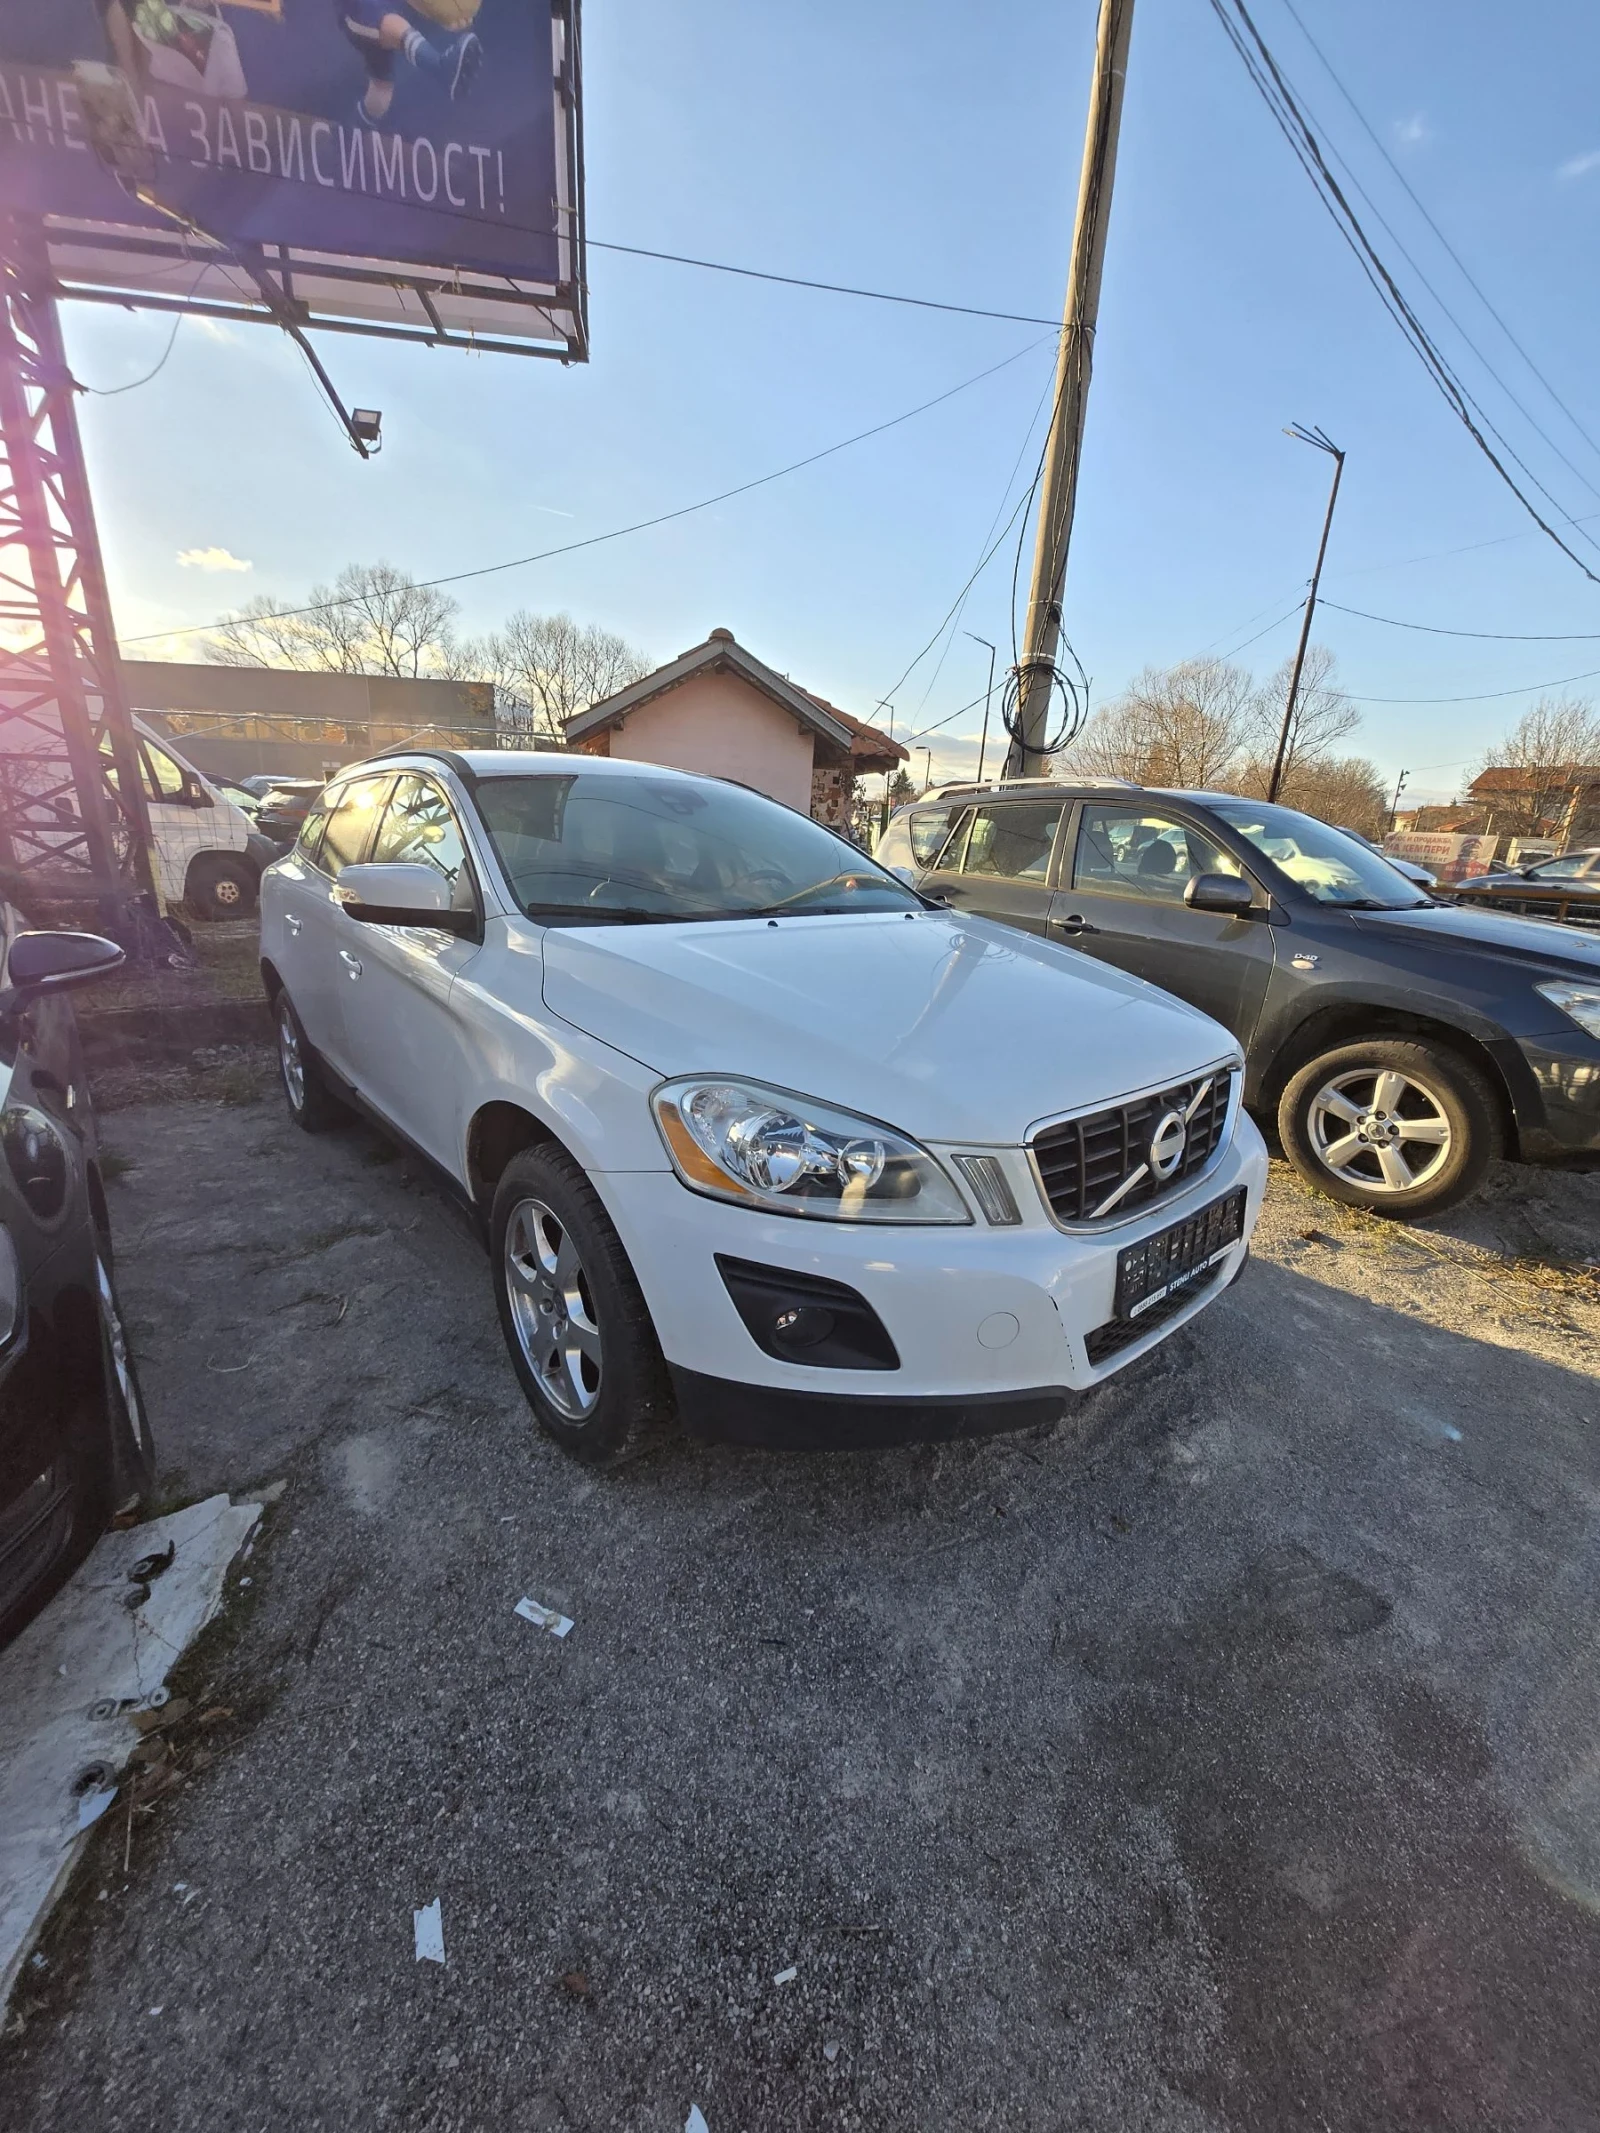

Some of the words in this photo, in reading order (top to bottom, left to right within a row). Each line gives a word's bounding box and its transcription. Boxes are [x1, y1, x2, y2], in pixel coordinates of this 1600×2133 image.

[185, 101, 506, 213] ЗАВИСИМОСТ!
[1403, 844, 1451, 855] КЕМПЕРИ
[1190, 1260, 1208, 1278] AUTO
